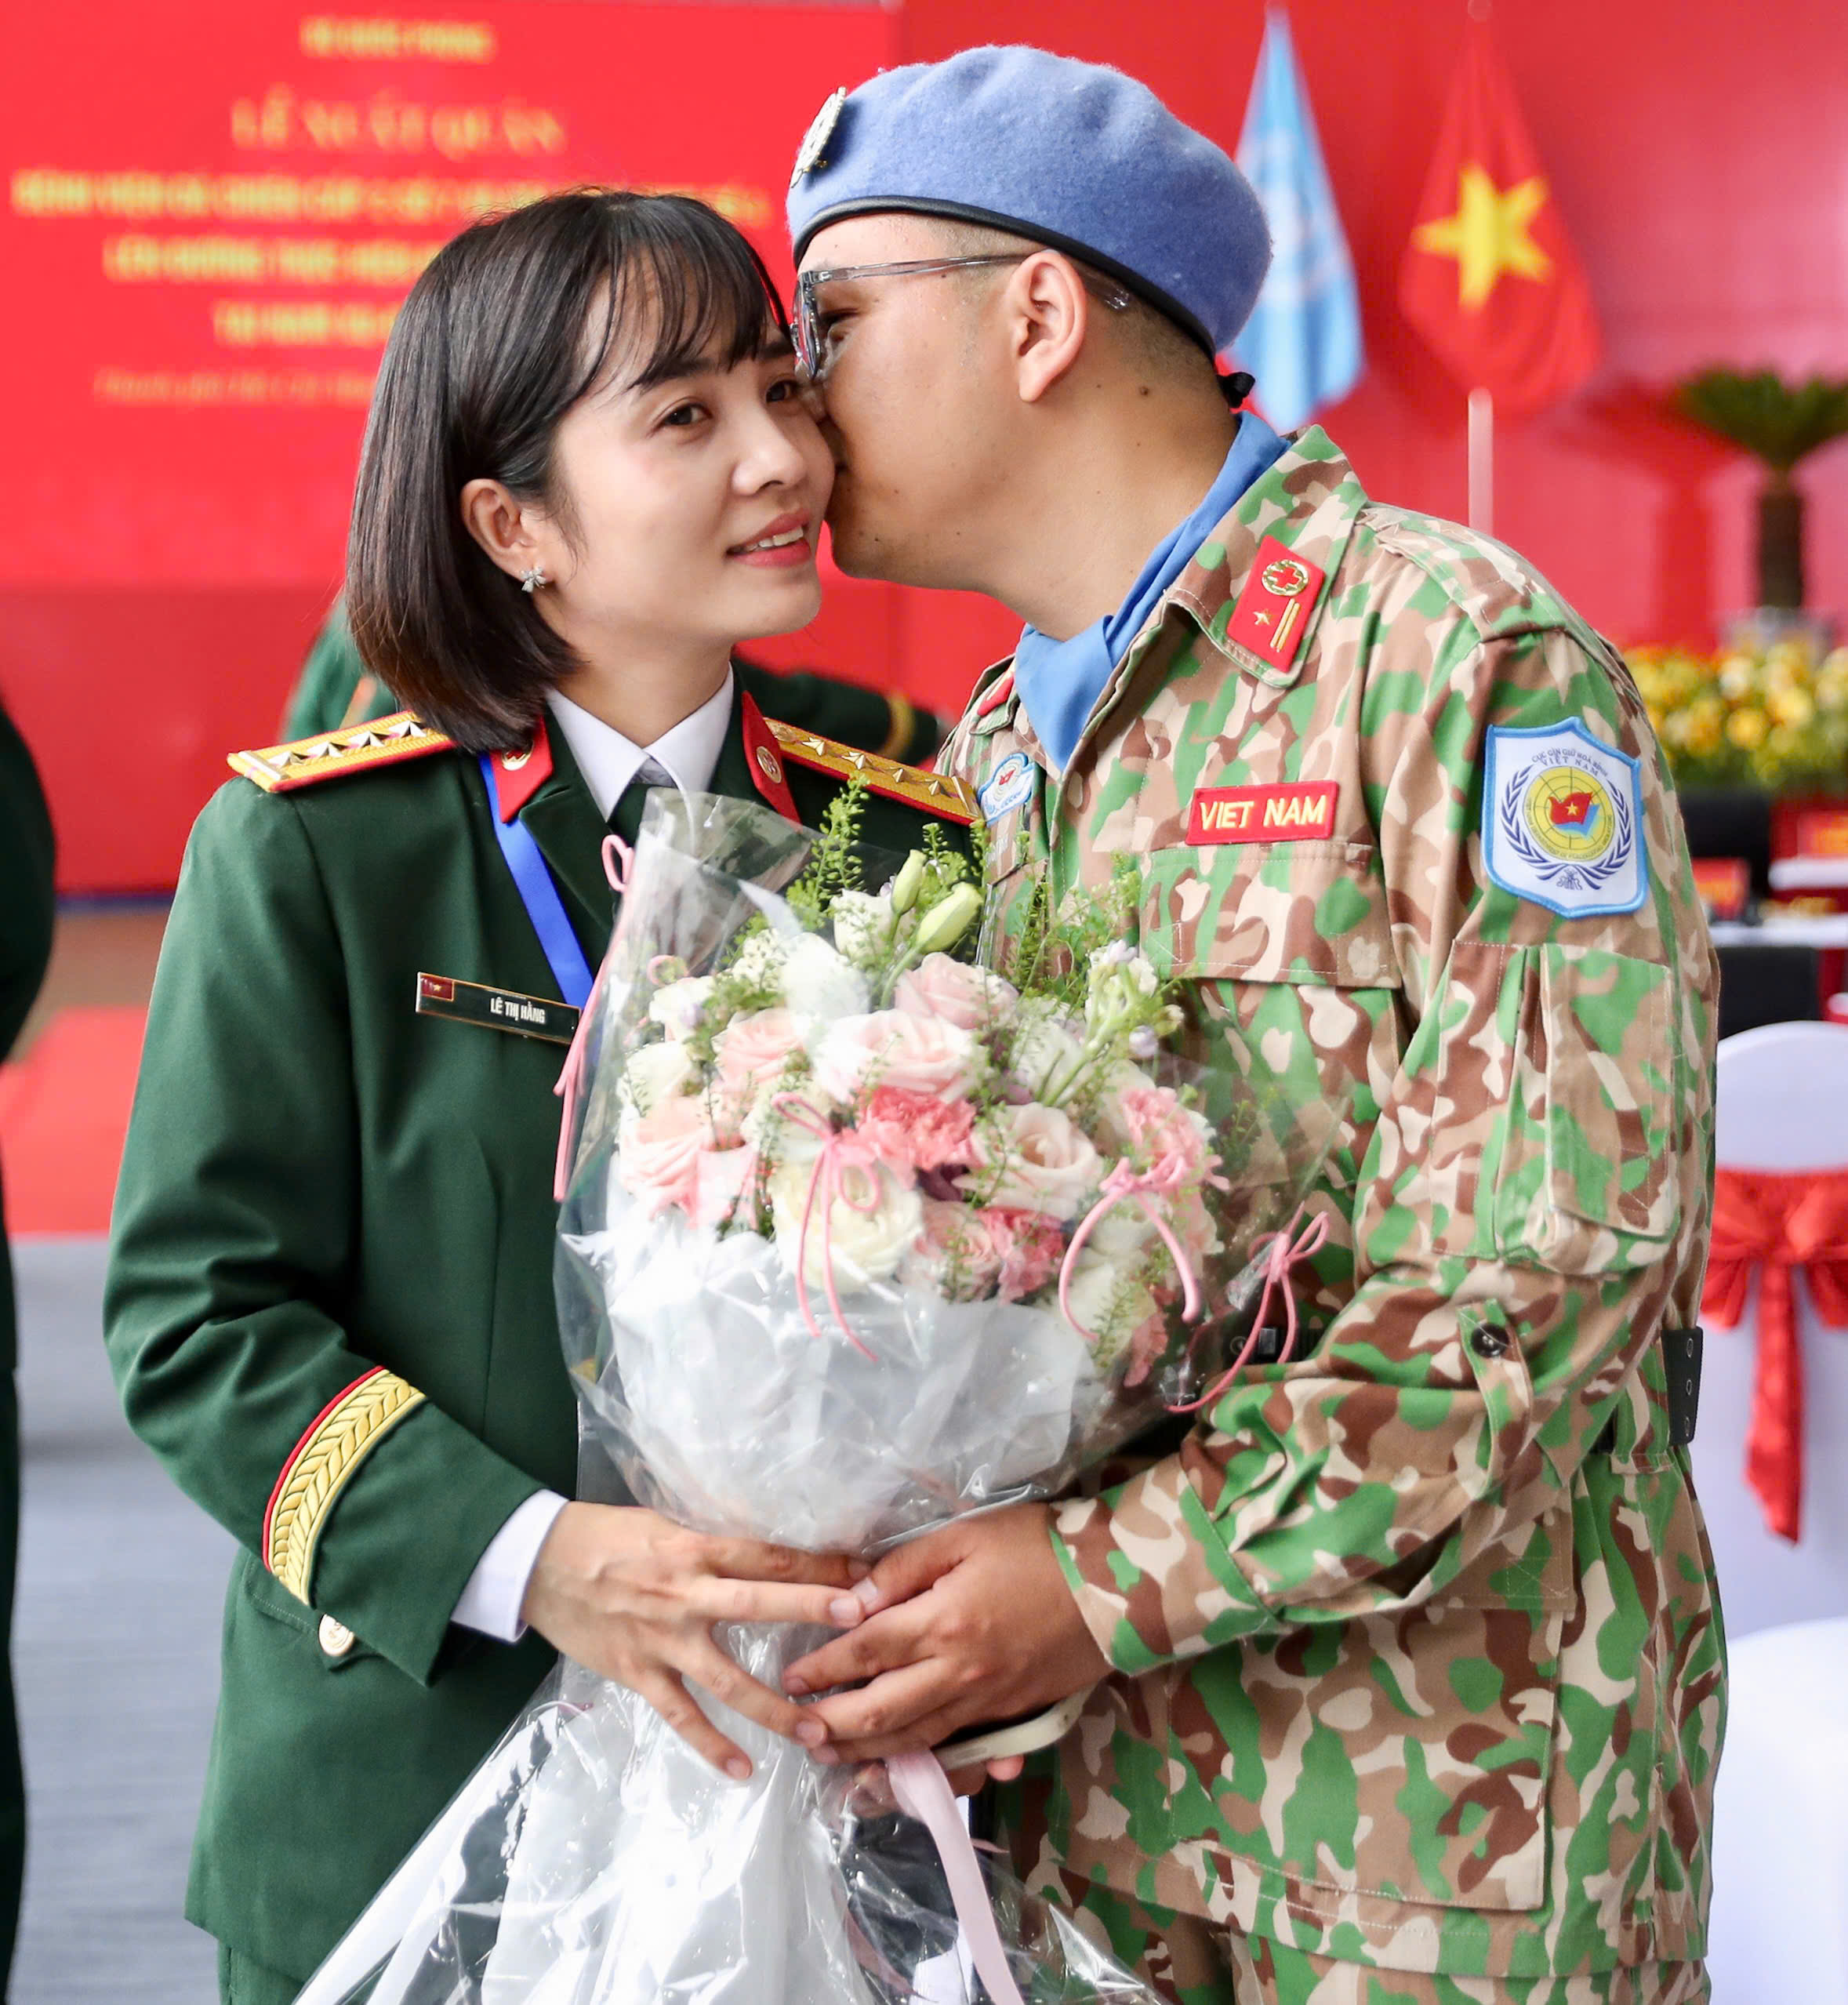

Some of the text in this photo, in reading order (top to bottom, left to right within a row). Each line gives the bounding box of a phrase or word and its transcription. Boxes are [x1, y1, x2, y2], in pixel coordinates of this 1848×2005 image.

[1575, 758, 1599, 776] NAM
[1200, 794, 1327, 830] VIET NAM
[490, 997, 503, 1015] LÊ
[504, 1001, 519, 1021] THỊ
